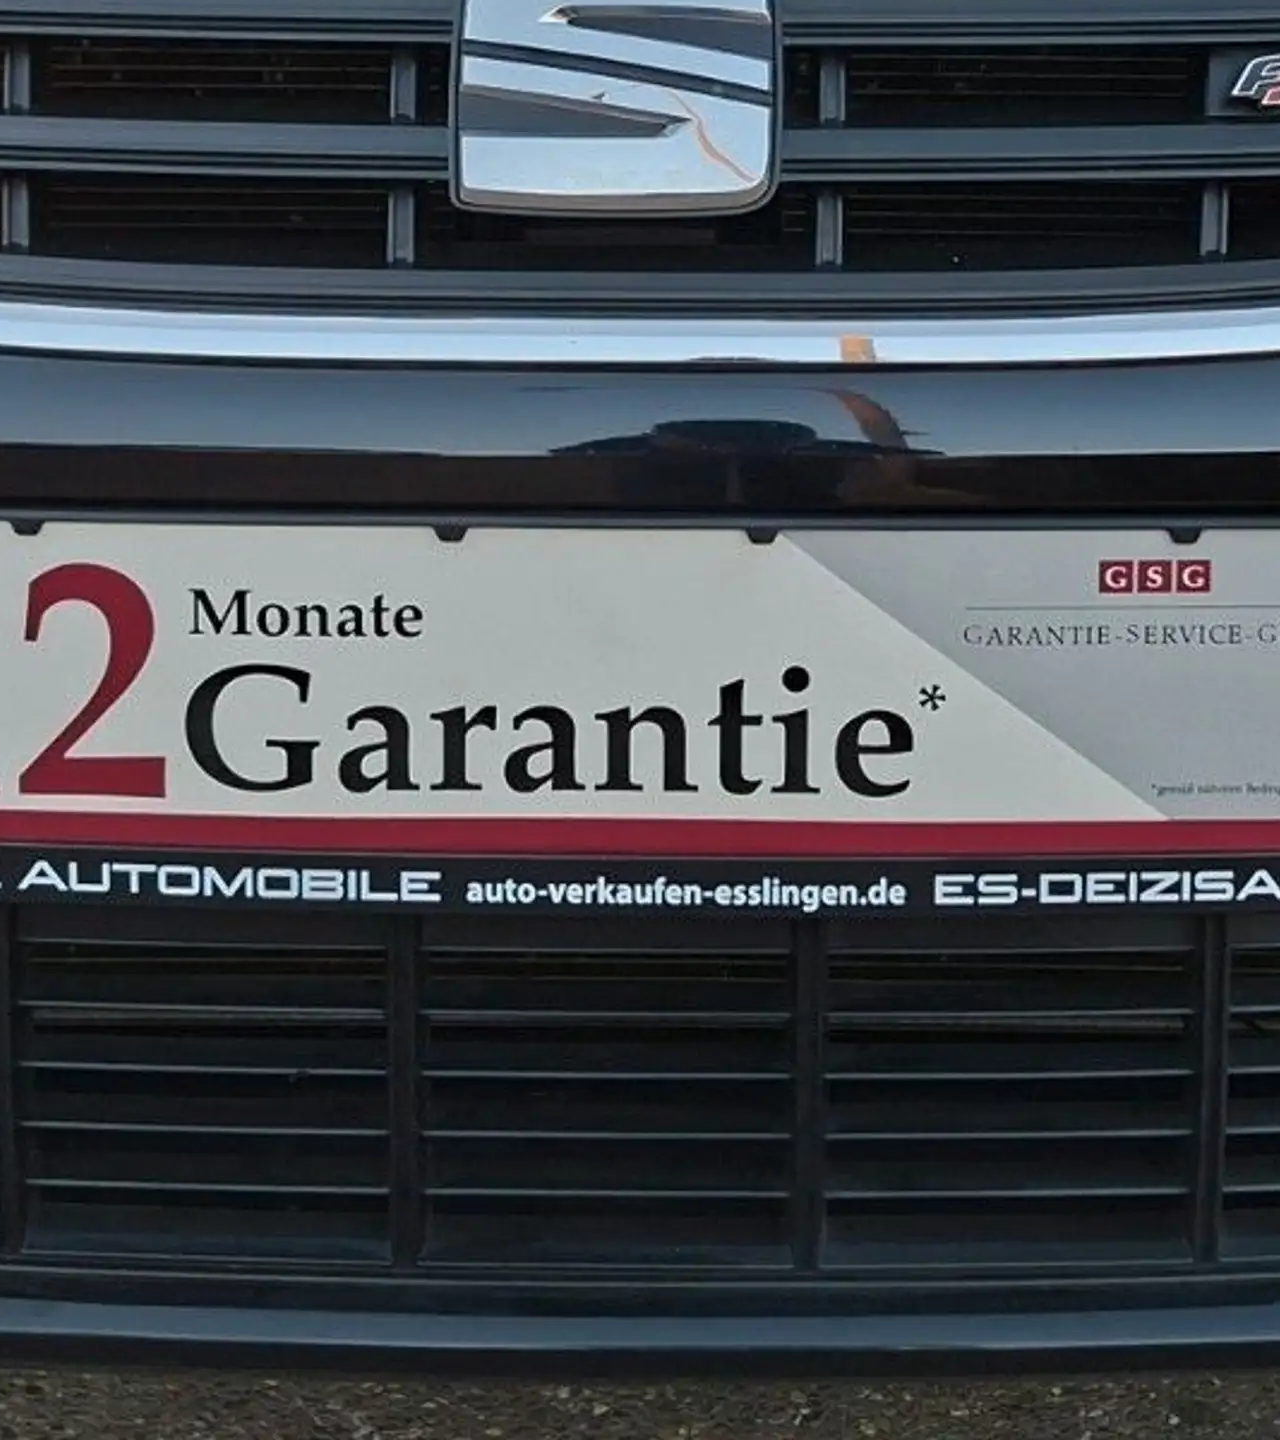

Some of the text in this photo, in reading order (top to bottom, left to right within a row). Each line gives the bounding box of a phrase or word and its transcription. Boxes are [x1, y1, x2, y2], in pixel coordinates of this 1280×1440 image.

[1101, 562, 1209, 592] GSG
[188, 588, 424, 639] Monate
[18, 861, 442, 903] AUTOMOBILE
[465, 877, 907, 913] auto-verkaufen-esslingen.de
